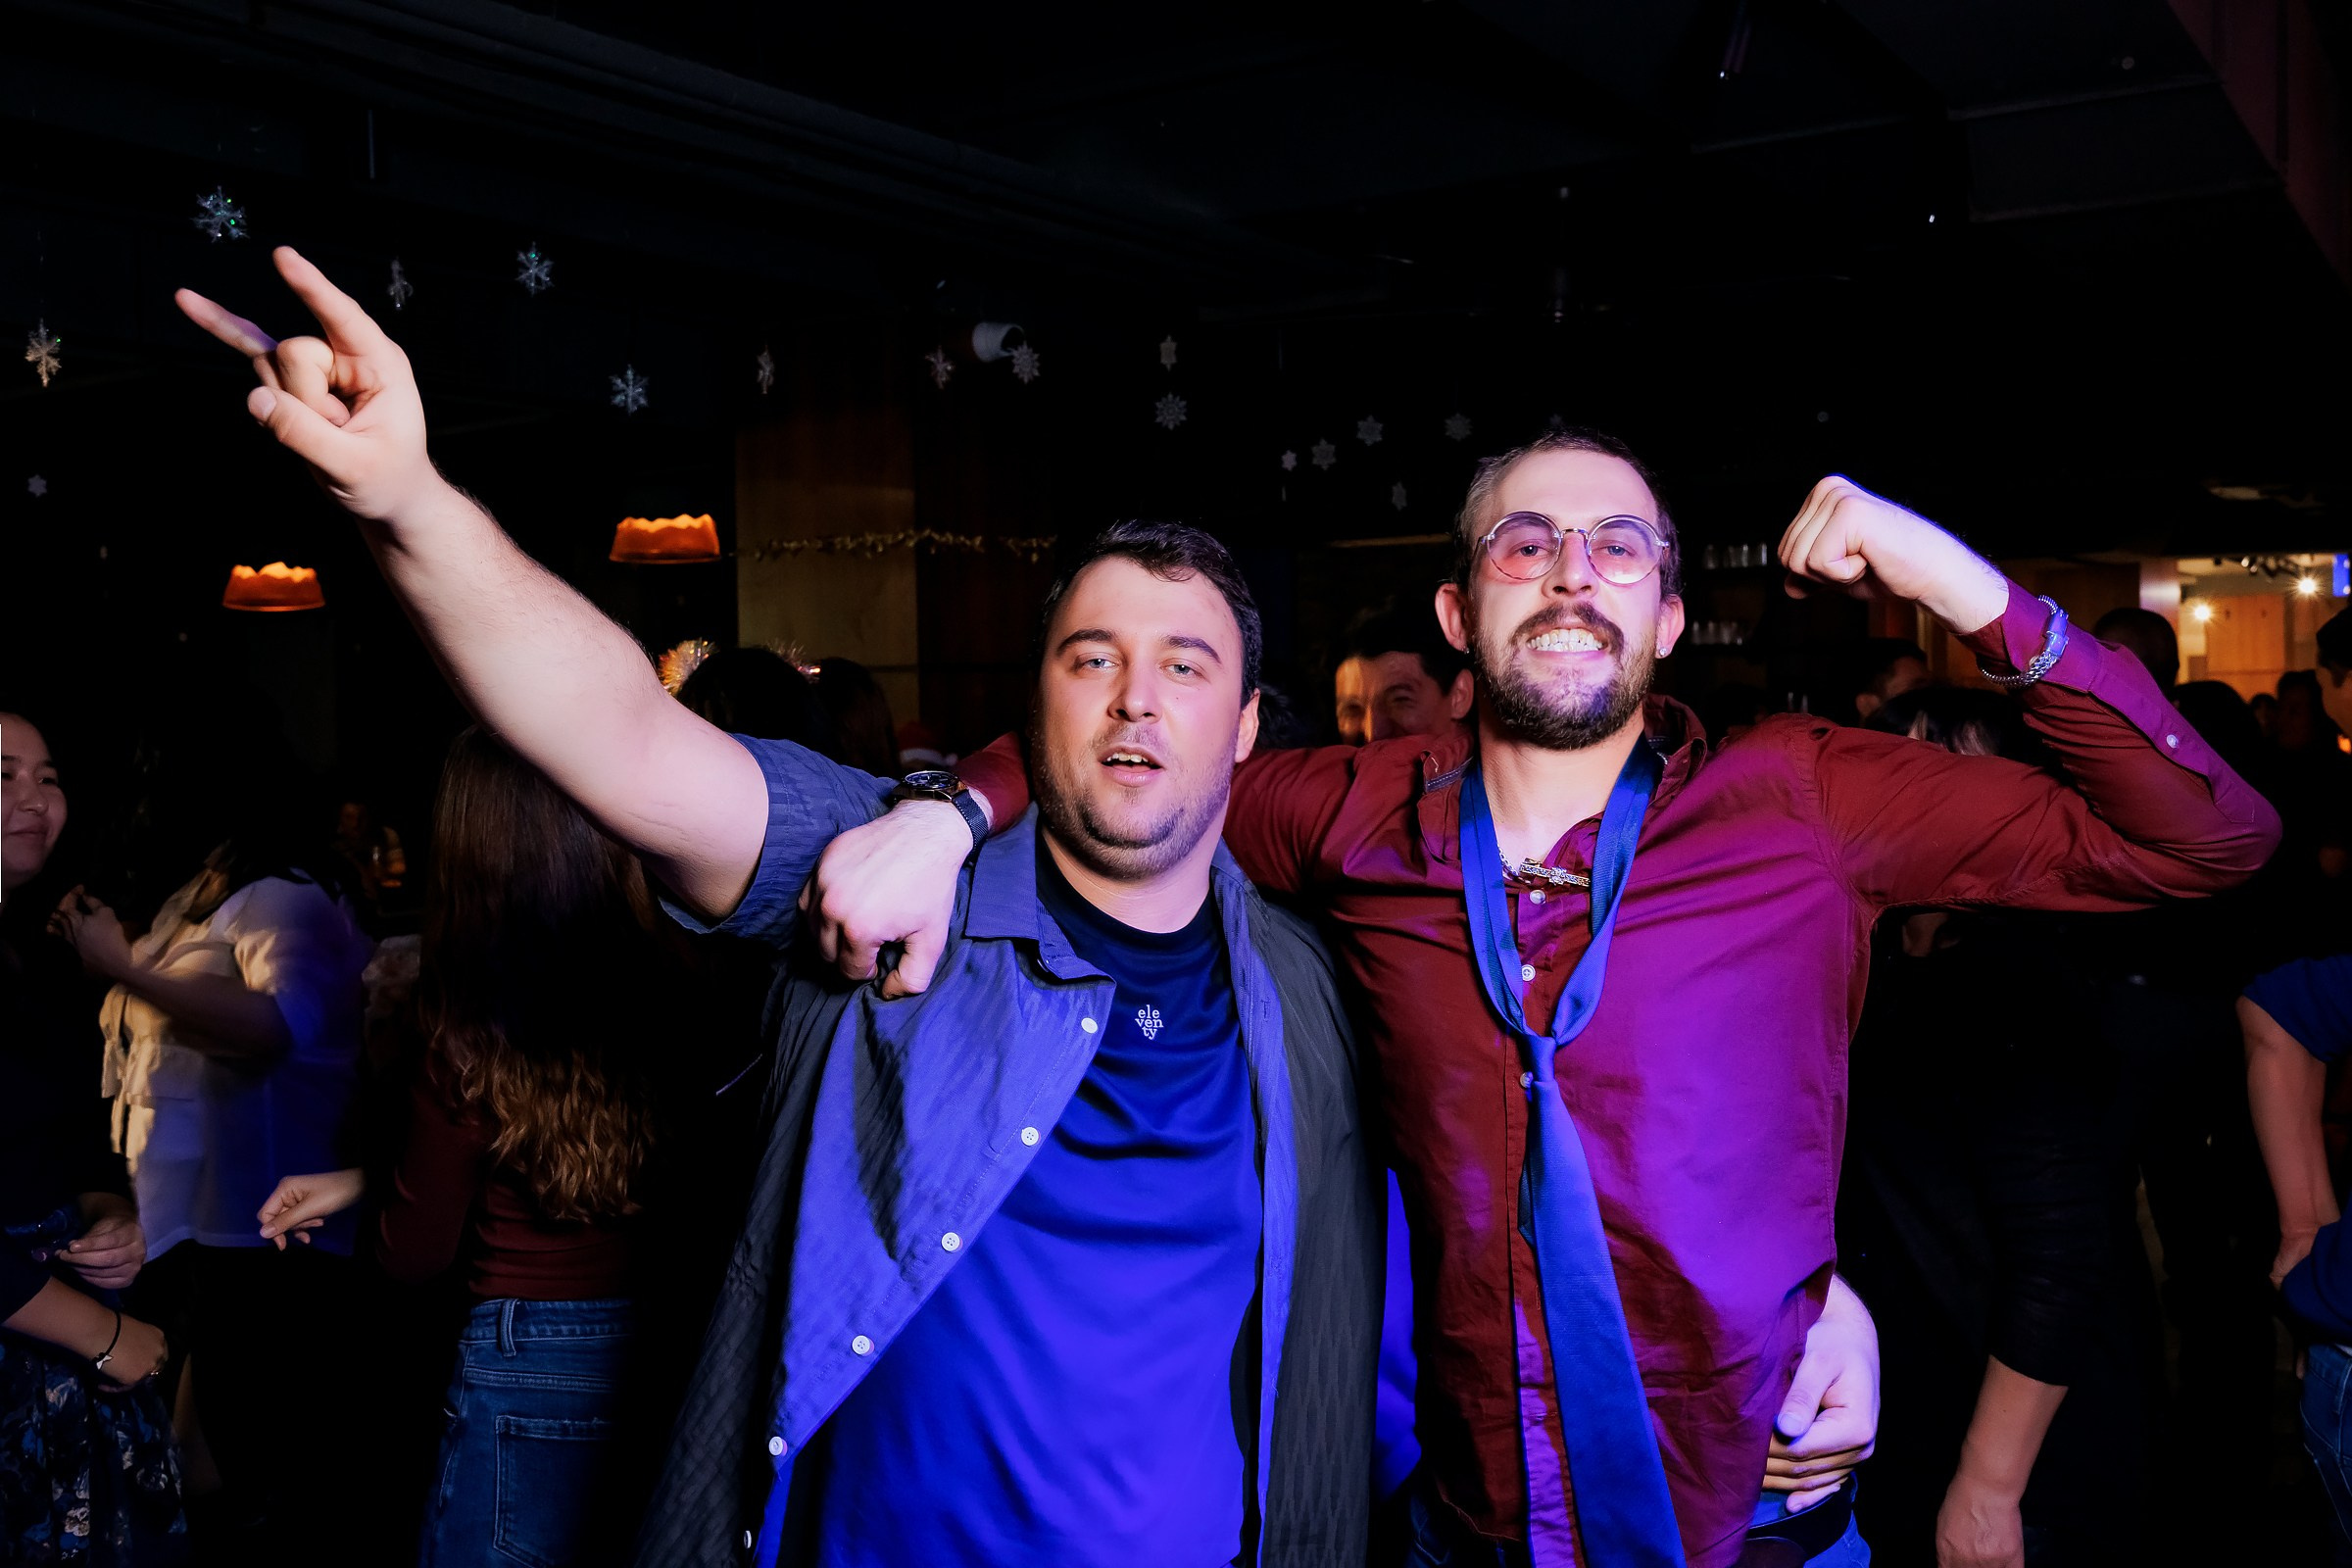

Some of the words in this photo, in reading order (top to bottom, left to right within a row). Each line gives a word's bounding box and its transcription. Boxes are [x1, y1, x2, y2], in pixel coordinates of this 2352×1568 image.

[1138, 1004, 1160, 1018] ele
[1135, 1018, 1164, 1028] ven
[1142, 1026, 1157, 1040] ty
